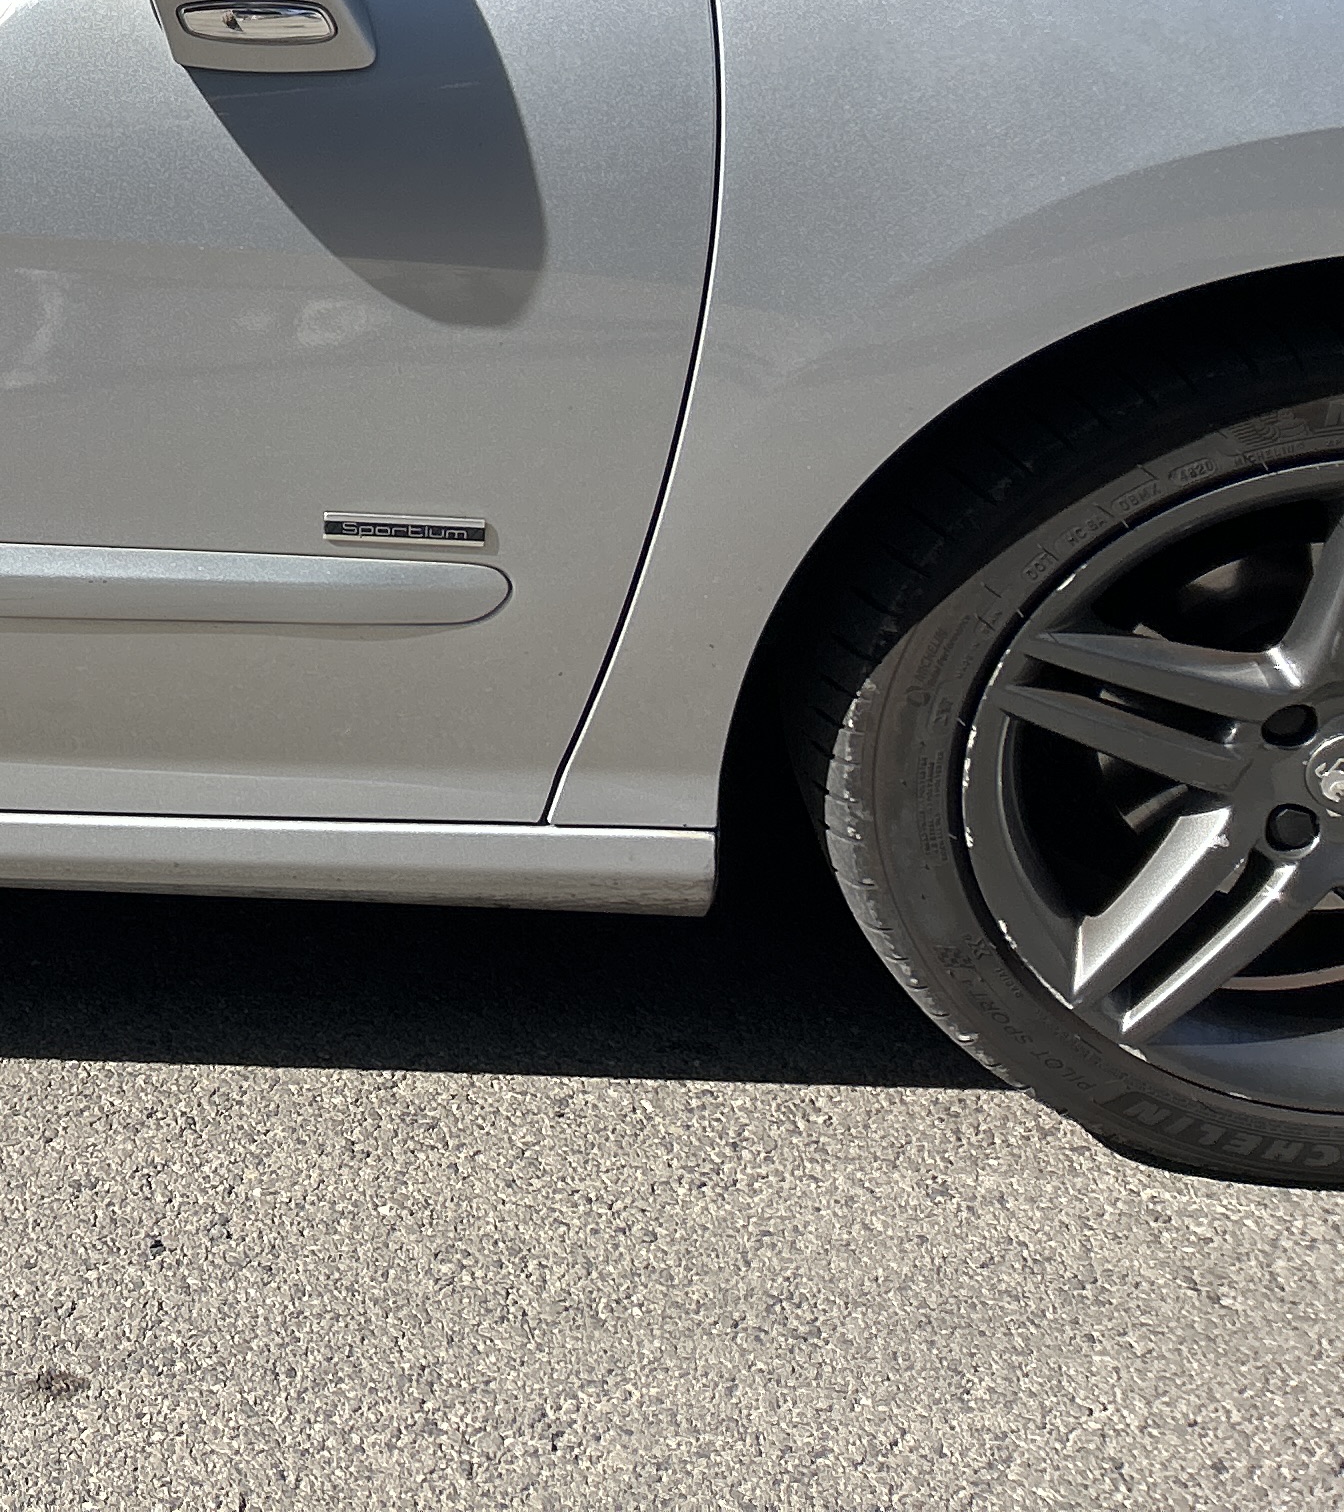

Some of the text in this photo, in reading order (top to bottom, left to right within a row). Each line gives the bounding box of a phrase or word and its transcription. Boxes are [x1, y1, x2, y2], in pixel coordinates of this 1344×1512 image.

[342, 522, 468, 540] Sportium
[968, 989, 1034, 1044] SPORT
[1029, 1049, 1097, 1091] PILOT
[1122, 1100, 1344, 1168] CHELIN
